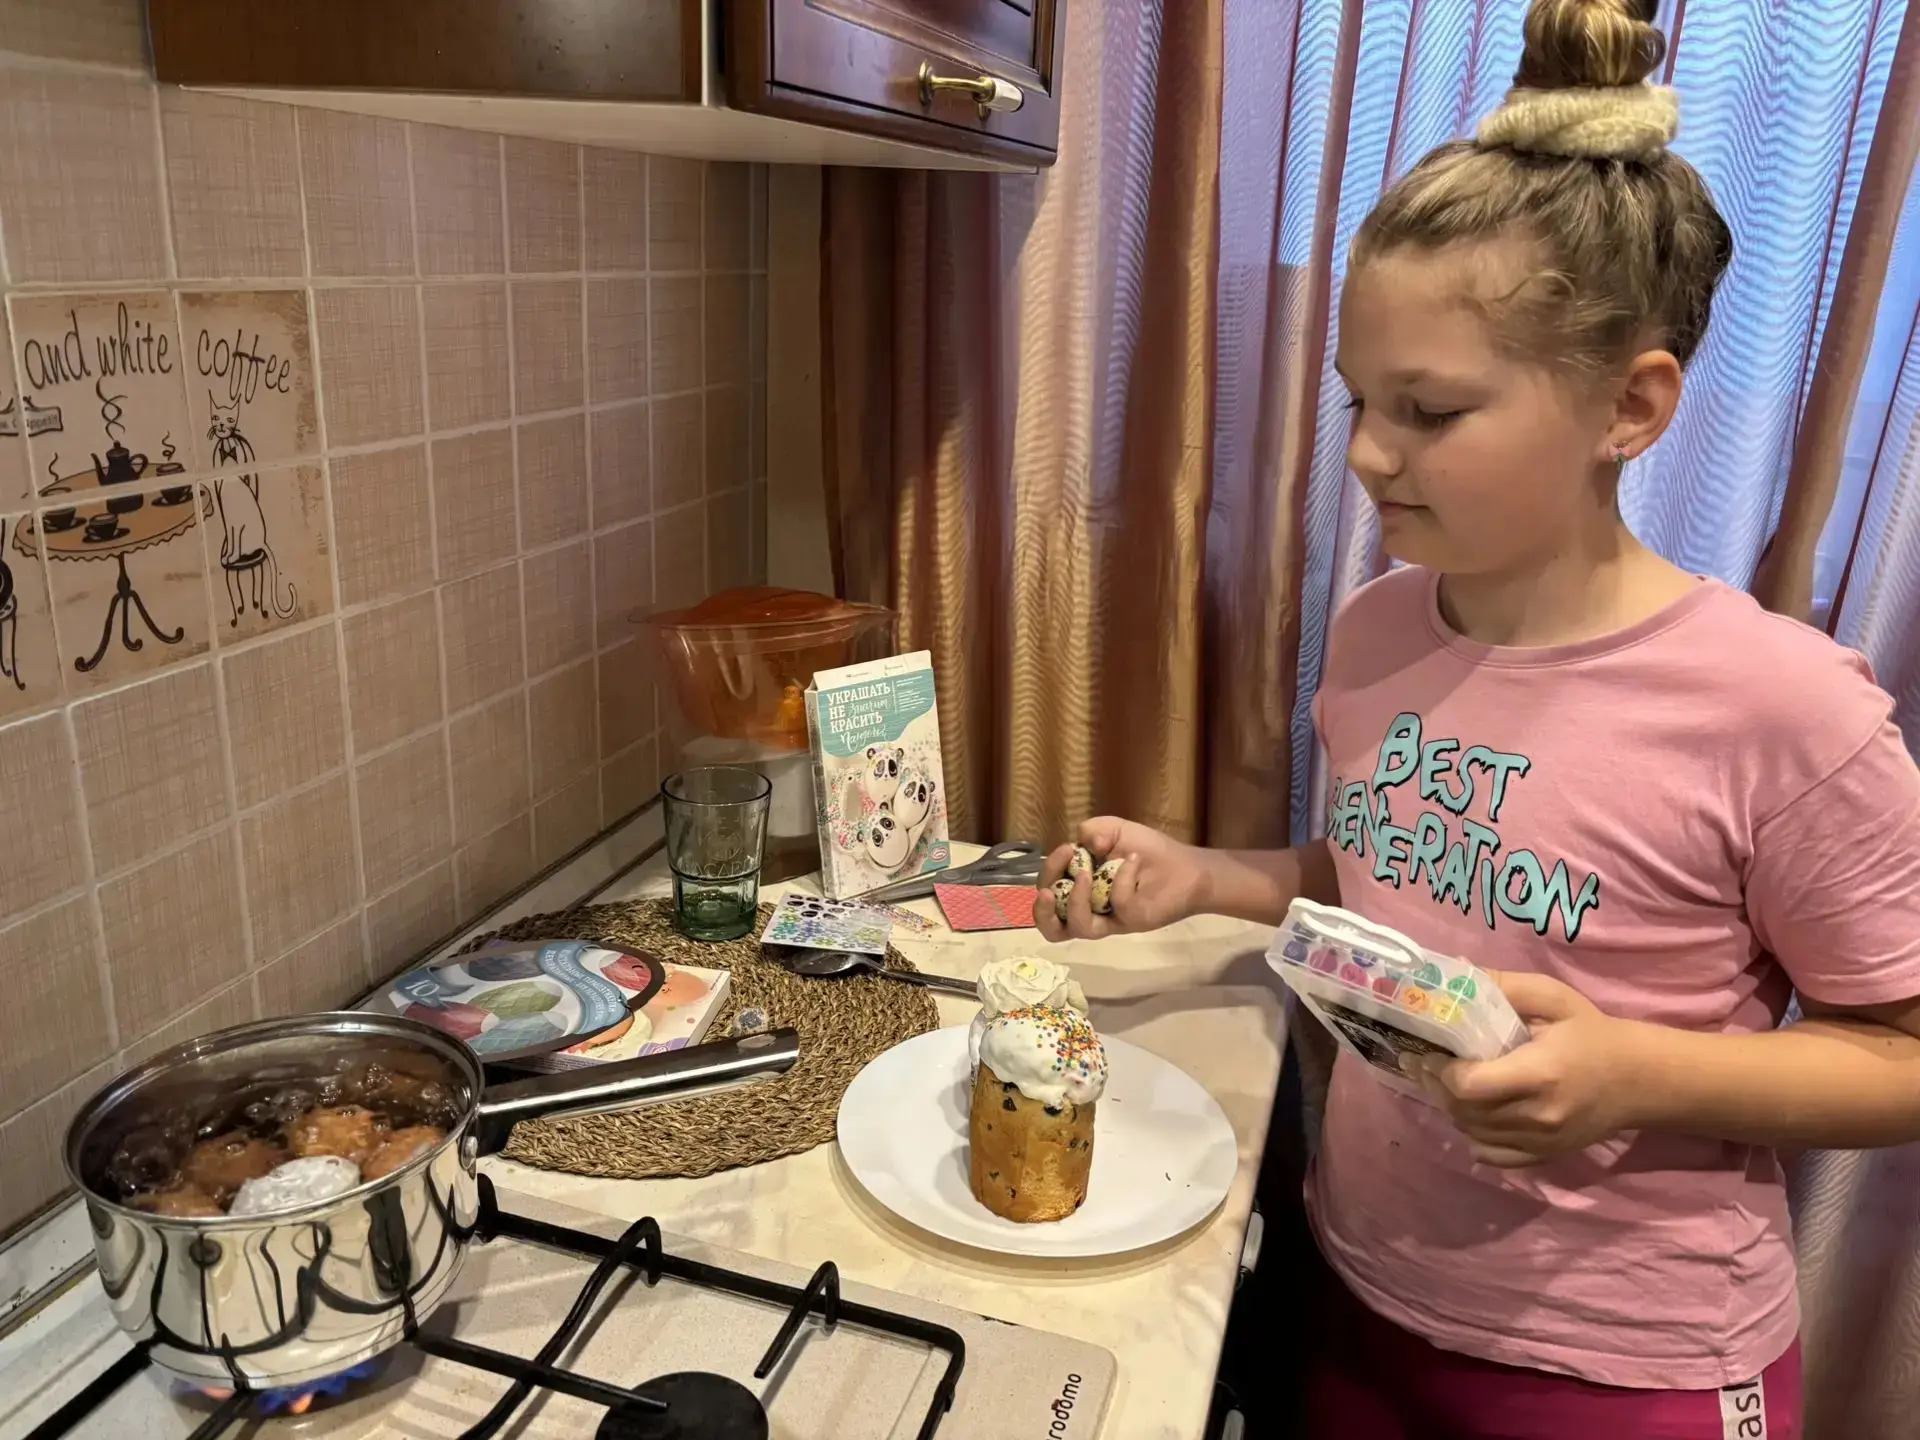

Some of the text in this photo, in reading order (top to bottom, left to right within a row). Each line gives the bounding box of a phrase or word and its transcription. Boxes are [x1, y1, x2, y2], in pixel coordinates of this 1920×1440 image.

[24, 301, 291, 404] and white coffee
[826, 682, 891, 707] УКРАШАТЬ
[829, 705, 846, 720] НЕ
[830, 711, 883, 734] КРАСИТЬ
[1372, 711, 1532, 823] BEST
[1046, 1373, 1082, 1440] rodomo
